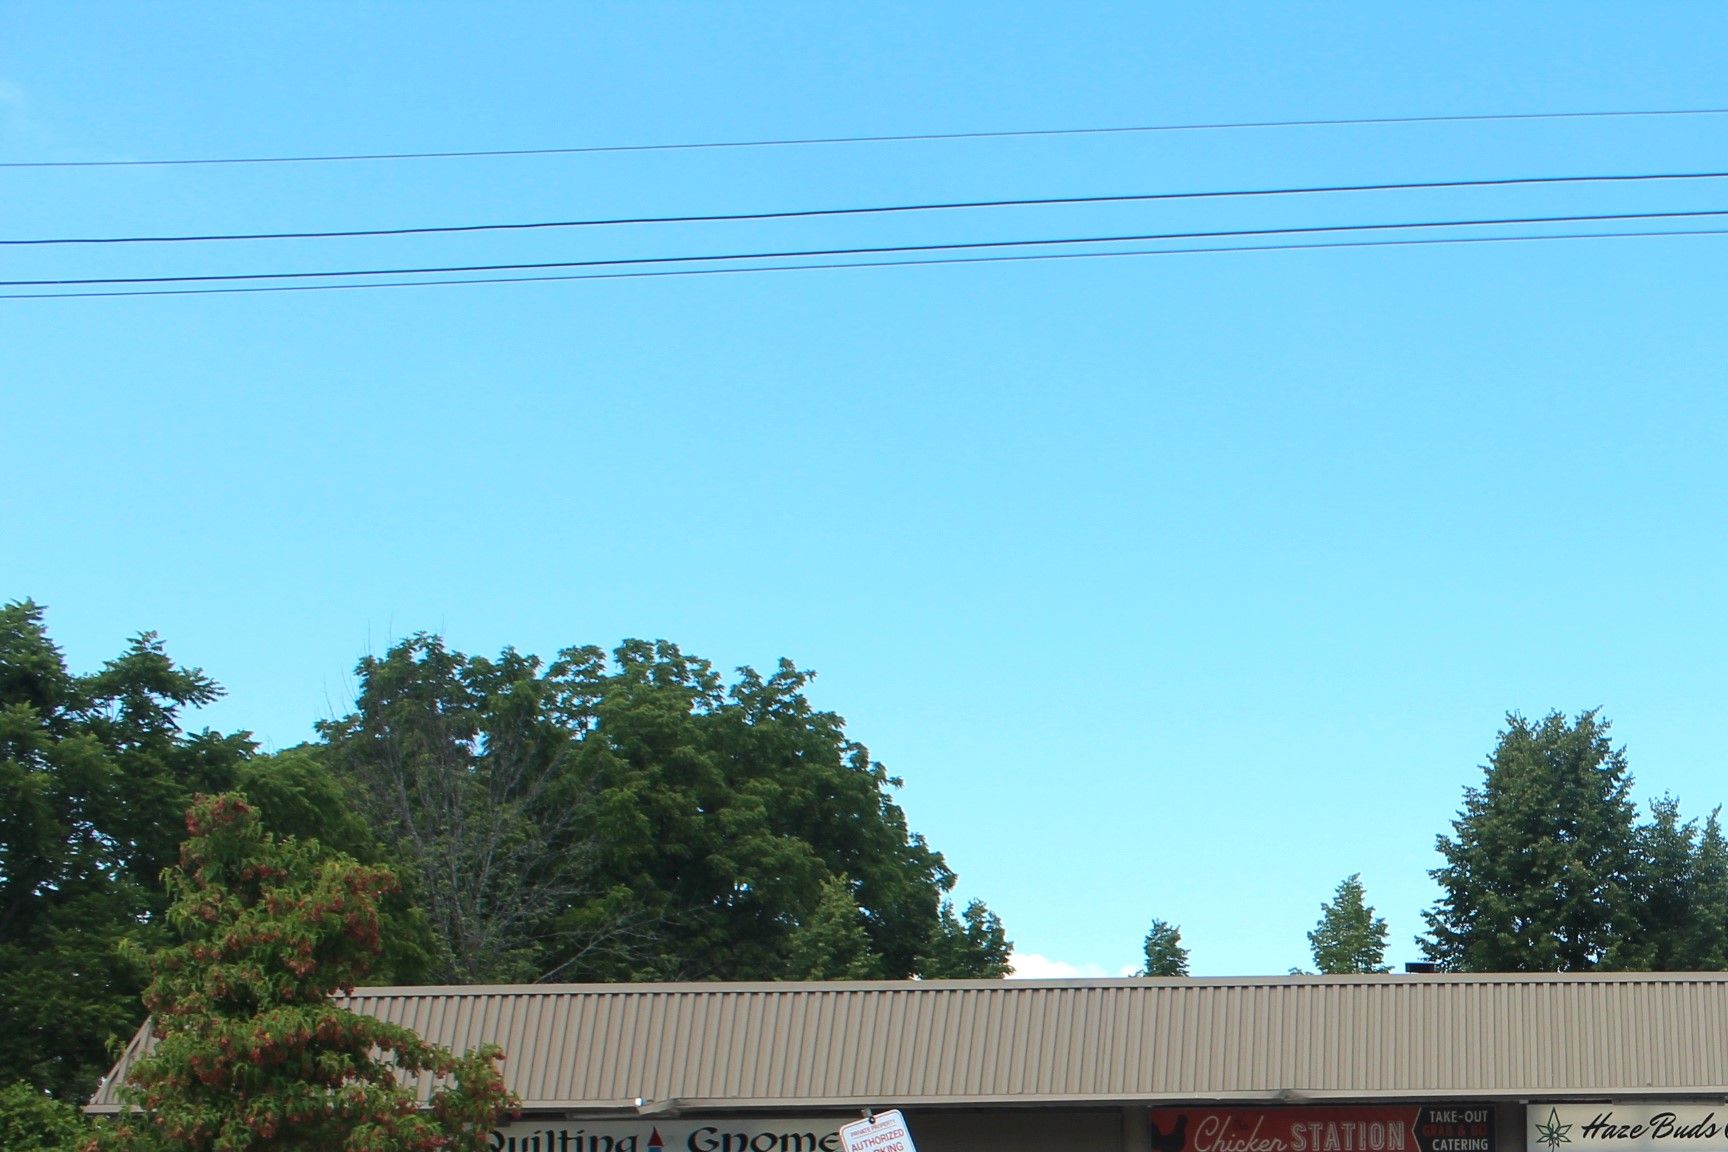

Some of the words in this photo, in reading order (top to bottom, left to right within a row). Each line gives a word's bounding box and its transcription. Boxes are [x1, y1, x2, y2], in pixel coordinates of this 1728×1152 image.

[1429, 1111, 1488, 1123] TAKE-OUT
[1581, 1112, 1649, 1140] Haze
[1650, 1112, 1723, 1140] Buds
[851, 1128, 904, 1152] AUTHORIZED
[1194, 1115, 1288, 1152] Chicken
[1290, 1120, 1405, 1151] STATION
[1432, 1138, 1488, 1151] CATERING
